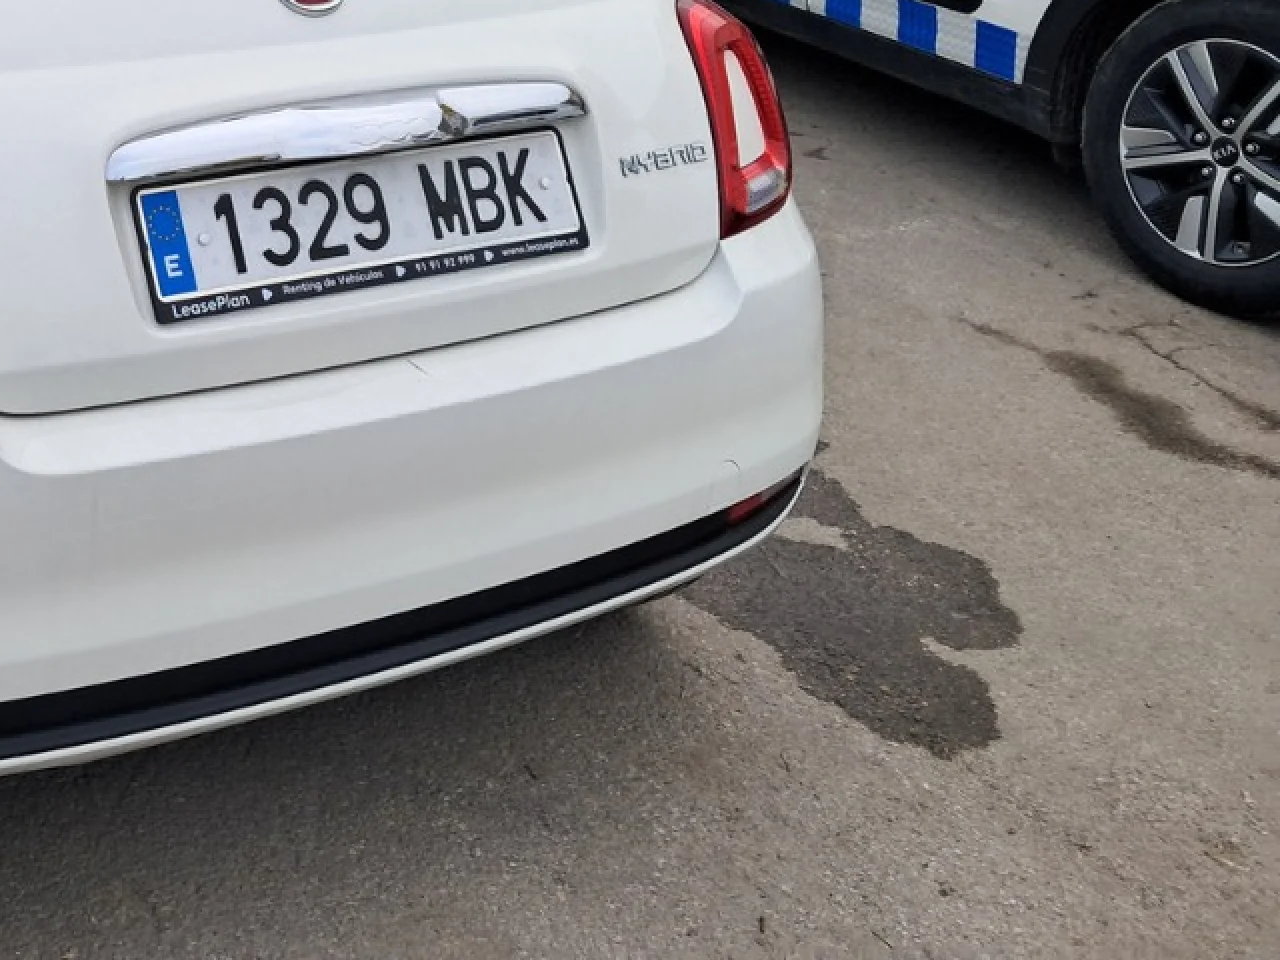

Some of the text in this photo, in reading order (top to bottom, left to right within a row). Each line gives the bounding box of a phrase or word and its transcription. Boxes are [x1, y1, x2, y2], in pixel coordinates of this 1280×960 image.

[618, 143, 708, 179] HYBRID
[212, 148, 548, 276] 1329 MBK
[163, 253, 184, 279] E
[171, 293, 251, 319] LeasePlan
[283, 280, 322, 296] Renting
[323, 276, 337, 288] de
